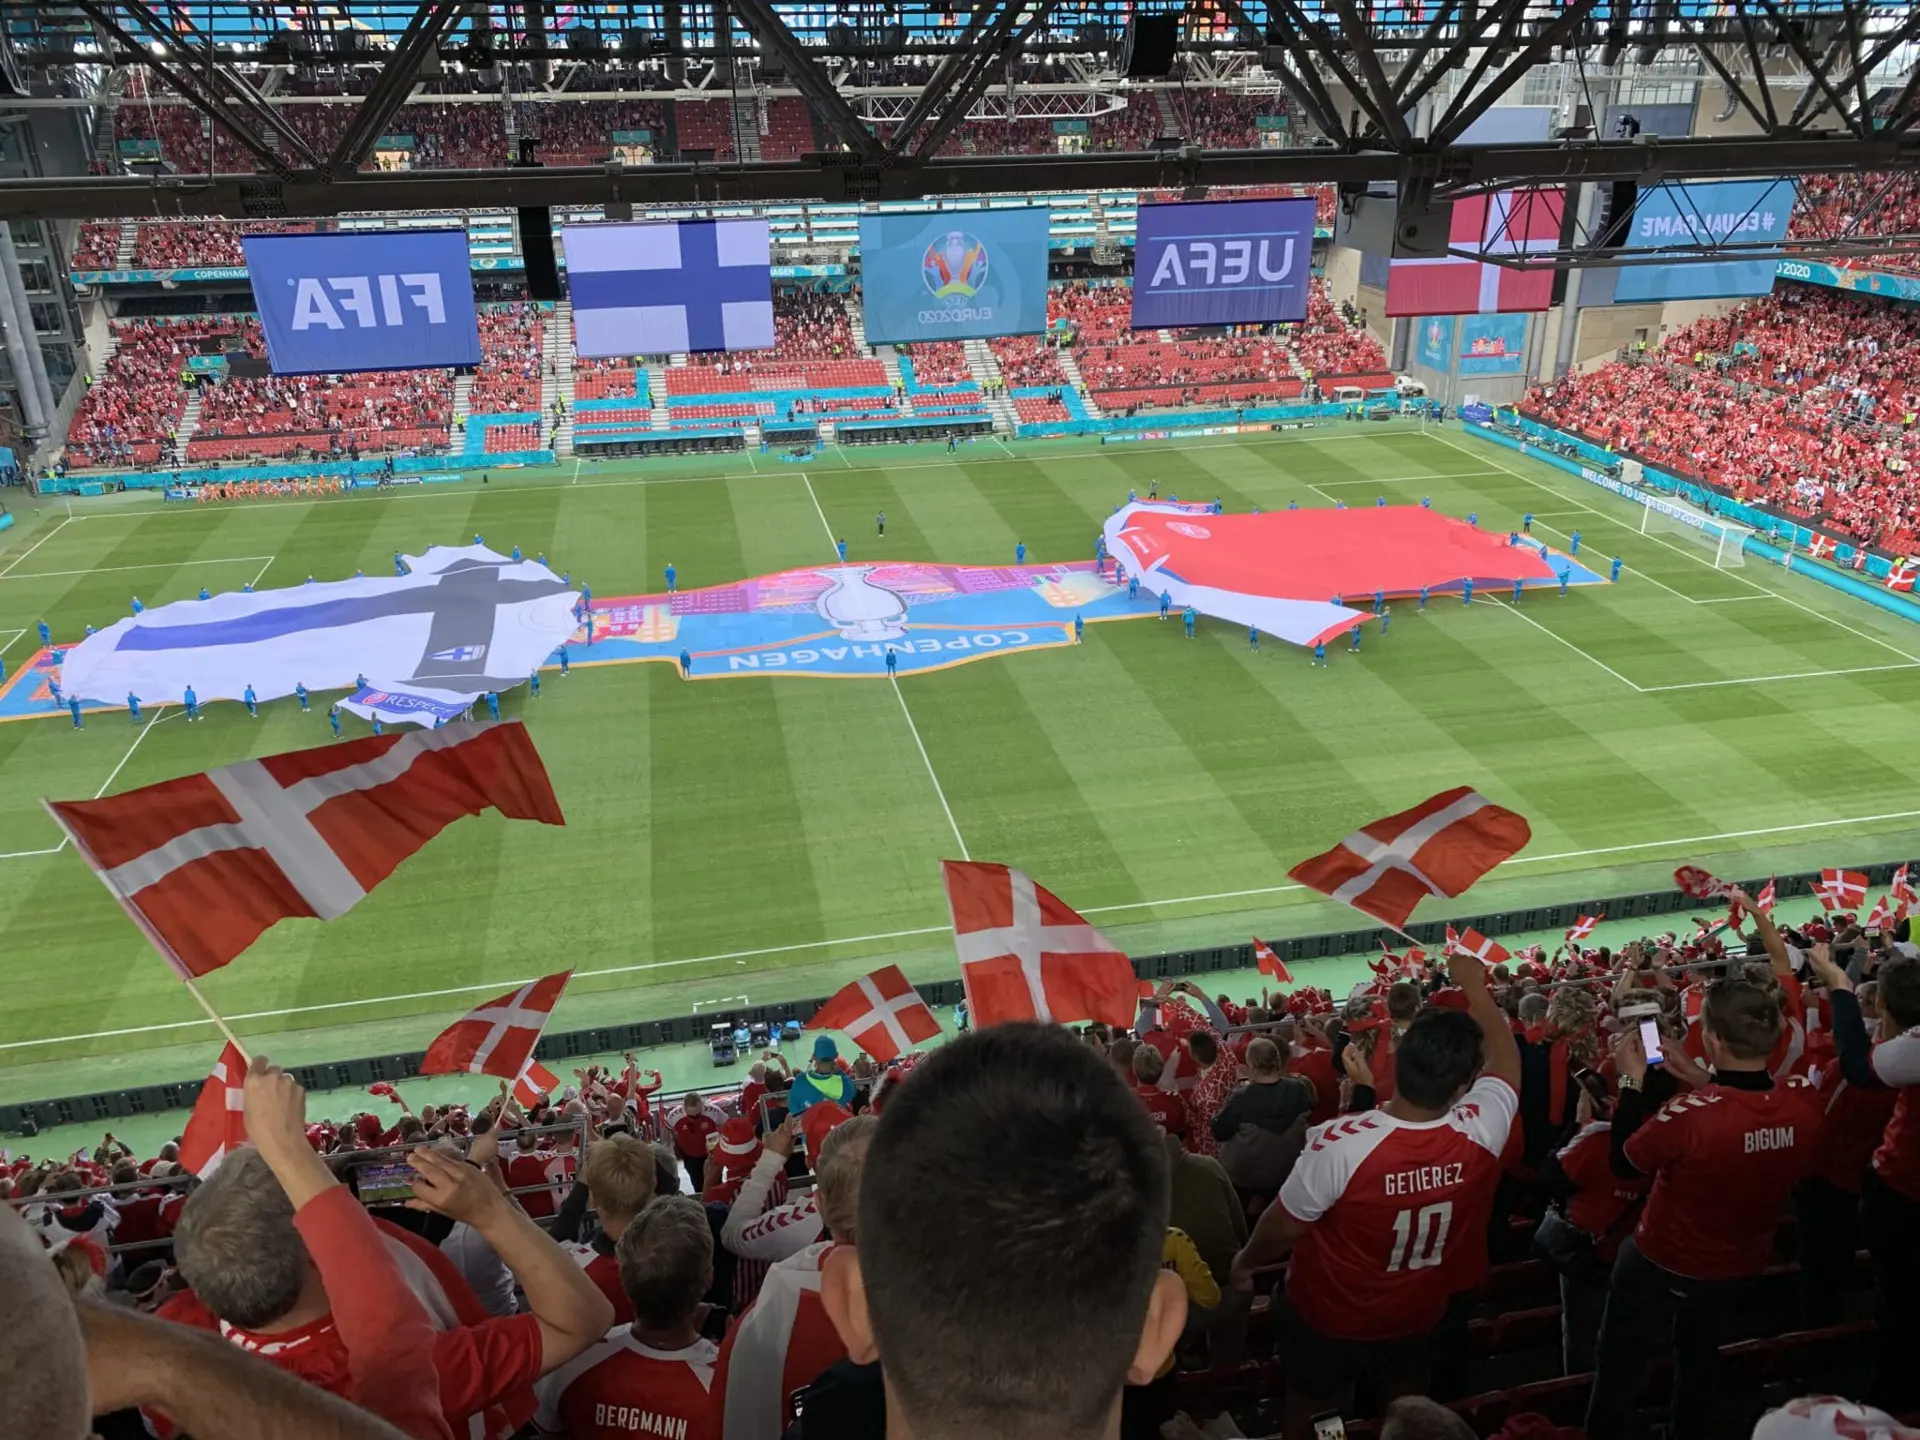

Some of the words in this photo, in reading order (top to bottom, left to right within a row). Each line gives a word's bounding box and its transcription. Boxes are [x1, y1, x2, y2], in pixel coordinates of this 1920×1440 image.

[194, 269, 250, 279] COPENHAGE
[1783, 262, 1811, 278] 2020
[1582, 467, 1621, 493] WELCOME
[1622, 483, 1633, 498] TO
[728, 630, 1030, 670] COPENHAGEN
[1743, 1126, 1794, 1154] BIGUM
[1385, 1162, 1464, 1196] GETIEREZ
[1386, 1201, 1453, 1273] 10
[595, 1403, 688, 1440] BERGMANN
